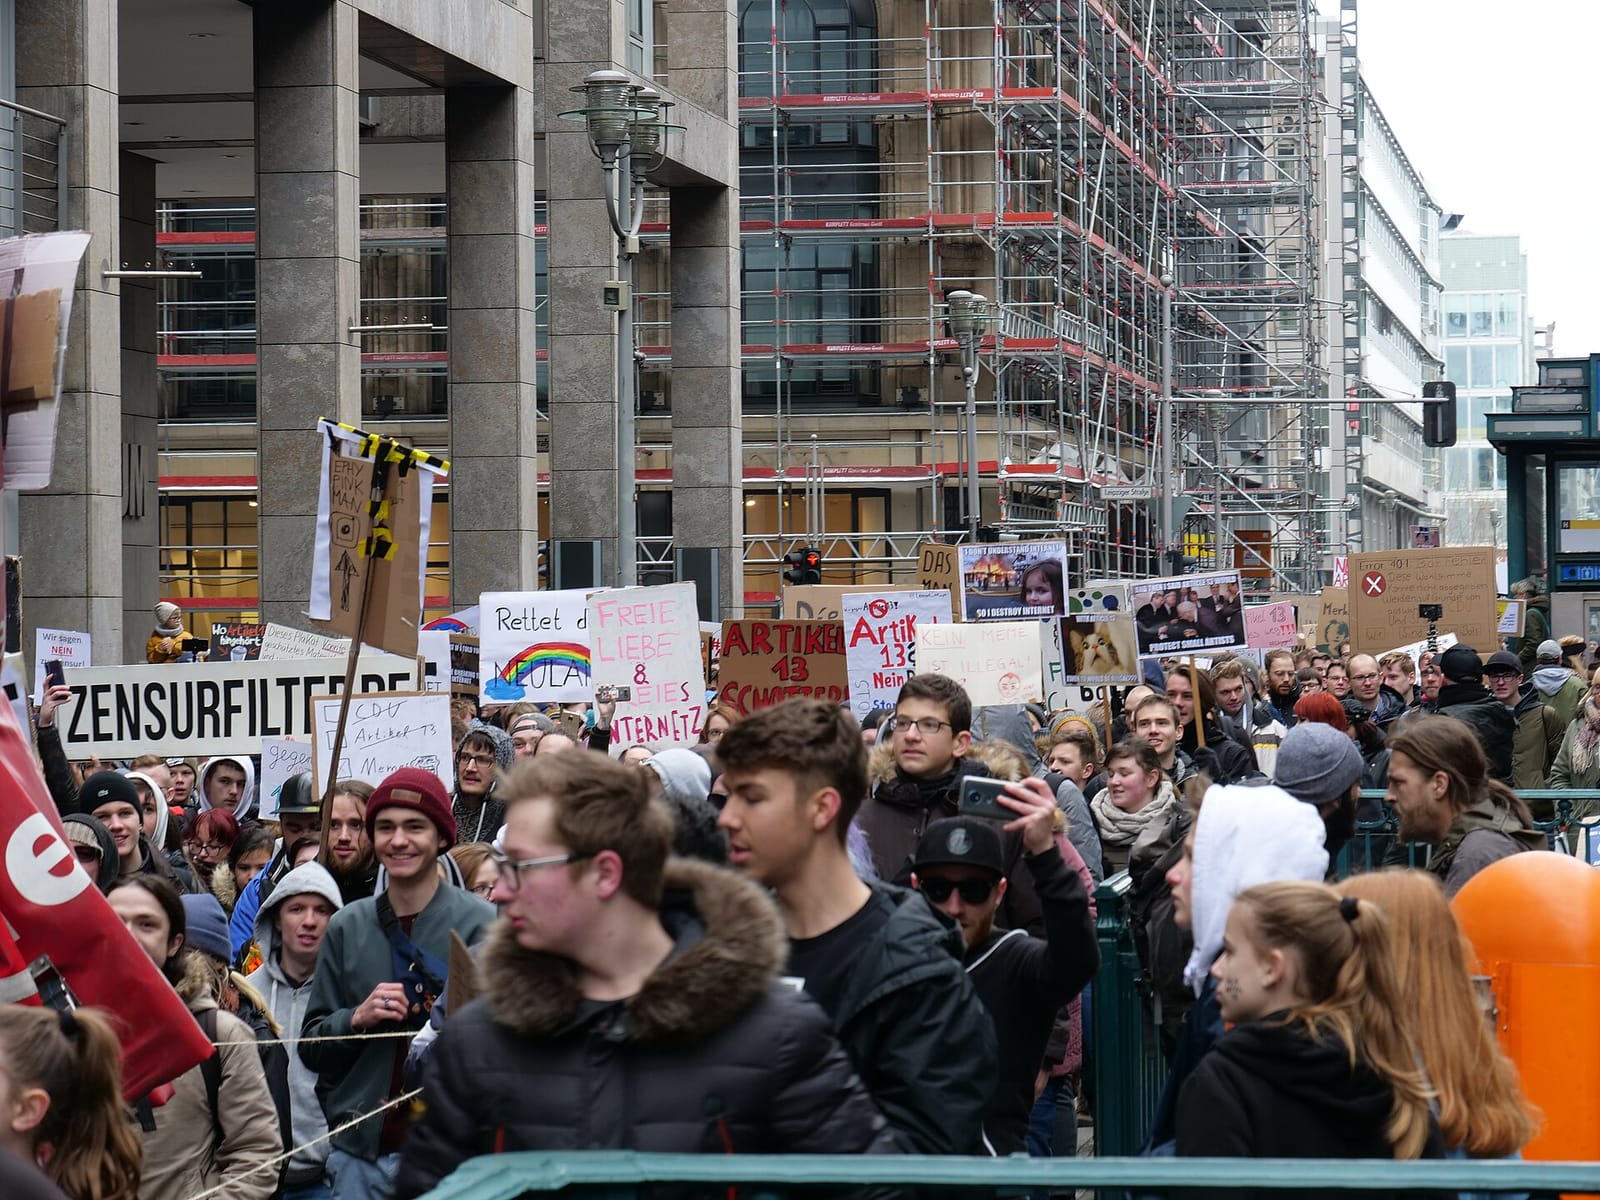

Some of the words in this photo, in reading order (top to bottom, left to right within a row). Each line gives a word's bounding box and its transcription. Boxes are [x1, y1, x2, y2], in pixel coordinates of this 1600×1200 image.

[332, 474, 364, 496] PINK
[1104, 488, 1130, 497] Leipziger
[987, 544, 1029, 554] UNDERSTAND
[922, 550, 952, 574] DAS
[1359, 560, 1385, 571] Error
[495, 606, 562, 632] Rettet
[596, 600, 677, 628] FREIE
[976, 608, 987, 618] SO
[991, 606, 1022, 617] DESTROY
[1022, 605, 1055, 616] INTERNET
[1269, 605, 1287, 623] 13
[42, 632, 57, 642] Wir
[58, 635, 82, 645] sagen
[212, 623, 228, 636] Wo
[267, 625, 293, 641] Dieses
[921, 629, 964, 646] KEIN
[981, 627, 1029, 645] MEME
[596, 632, 680, 662] LIEBE
[722, 622, 847, 657] ARTIKEL
[1148, 641, 1181, 653] PROTECT
[1181, 638, 1204, 649] SMALL
[1204, 635, 1236, 647] ARTISTS
[51, 645, 73, 655] NEIN
[633, 663, 650, 685] &
[771, 655, 809, 682] 13
[872, 671, 904, 689] Nein
[627, 681, 690, 707] EIES
[355, 701, 402, 720] CDU
[609, 705, 704, 745] NTERNETZ
